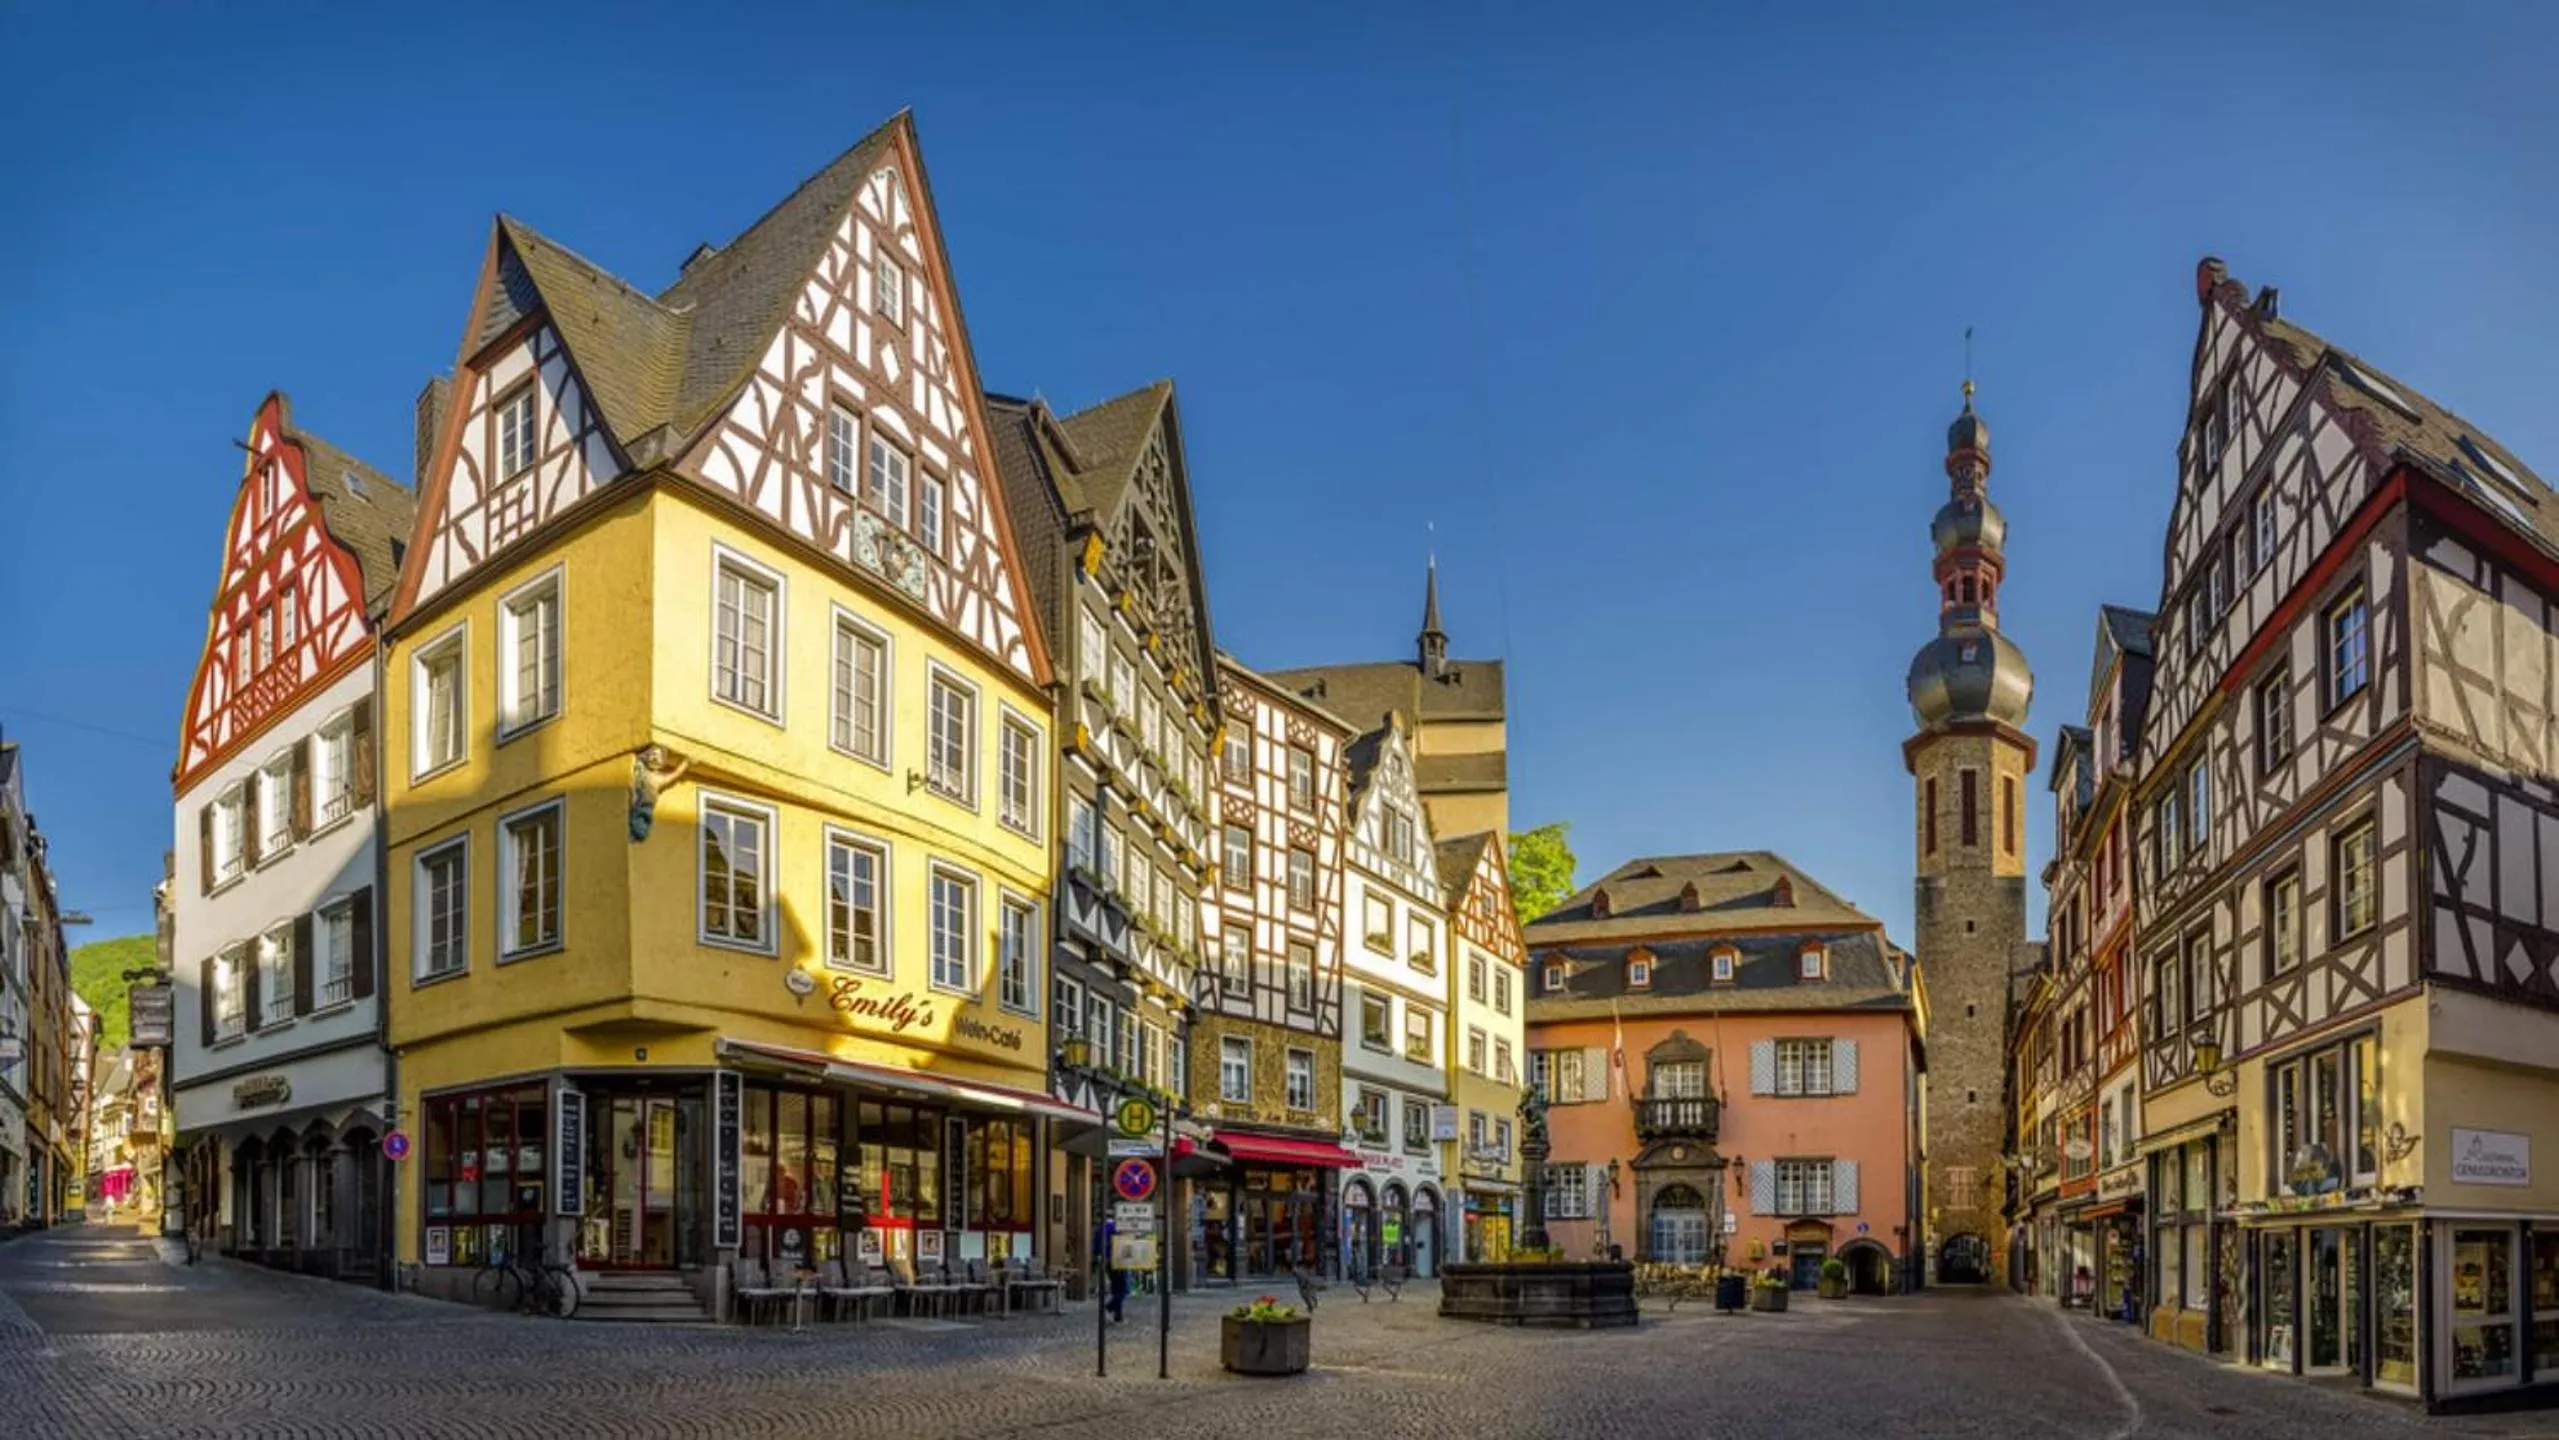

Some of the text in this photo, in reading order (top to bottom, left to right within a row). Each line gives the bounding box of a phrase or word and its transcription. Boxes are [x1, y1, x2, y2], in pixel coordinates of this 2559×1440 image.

[829, 976, 933, 1032] Emily's
[955, 1015, 1022, 1051] Wein-Café
[1127, 1103, 1145, 1129] H
